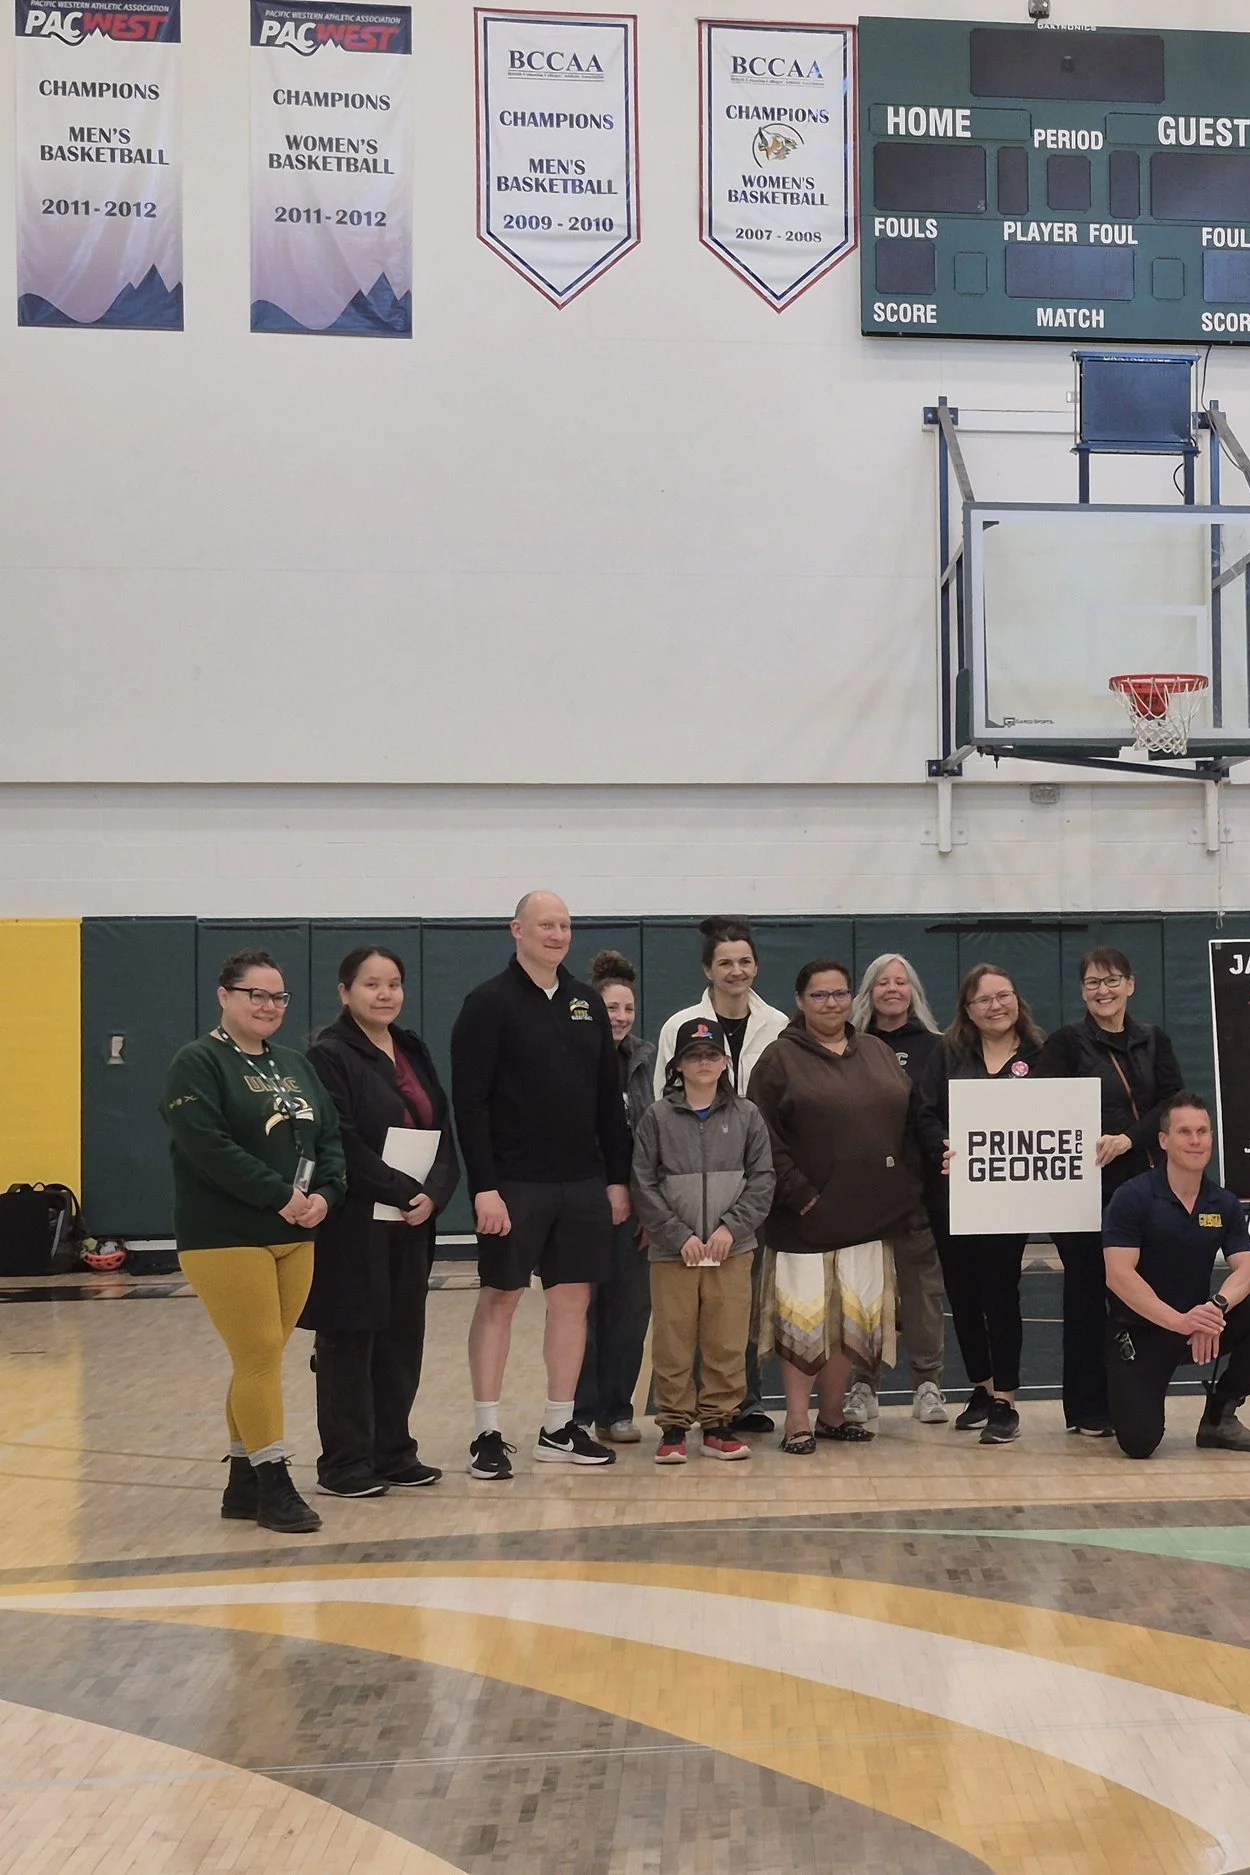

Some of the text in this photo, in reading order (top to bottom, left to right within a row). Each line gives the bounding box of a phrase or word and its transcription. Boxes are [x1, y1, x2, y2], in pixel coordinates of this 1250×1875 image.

[58, 1, 90, 9] WESTERN
[123, 4, 169, 12] ASSOCIATION
[265, 10, 401, 24] PACIFIC WESTERN ATHLETIC ASSOCIATION
[508, 50, 604, 72] BCCAA
[731, 56, 823, 79] BCCAA
[39, 79, 160, 100] CHAMPIONS
[273, 88, 391, 111] CHAMPIONS
[499, 110, 614, 131] CHAMPIONS
[725, 104, 830, 124] CHAMPIONS
[886, 106, 971, 138] HOME
[69, 127, 131, 144] MEN'S
[1033, 129, 1103, 150] PERIOD
[1157, 116, 1250, 147] GUEST
[285, 134, 378, 154] WOMEN'S
[40, 146, 170, 165] BASKETBALL
[268, 154, 394, 175] BASKETBALL
[529, 158, 586, 175] MEN'S
[496, 176, 618, 196] BASKETBALL
[741, 174, 815, 190] WOMEN'S
[727, 190, 829, 207] BASKETBALL
[503, 214, 553, 231] 2009
[568, 216, 614, 233] 2010
[874, 217, 938, 239] FOULS
[1003, 221, 1138, 245] PLAYER FOUL
[735, 228, 773, 242] 2007
[785, 232, 823, 243] 2008
[873, 302, 937, 324] SCORE
[1036, 307, 1105, 328] MATCH
[968, 1129, 1072, 1156] PRINCE
[968, 1156, 1083, 1182] GEORGE
